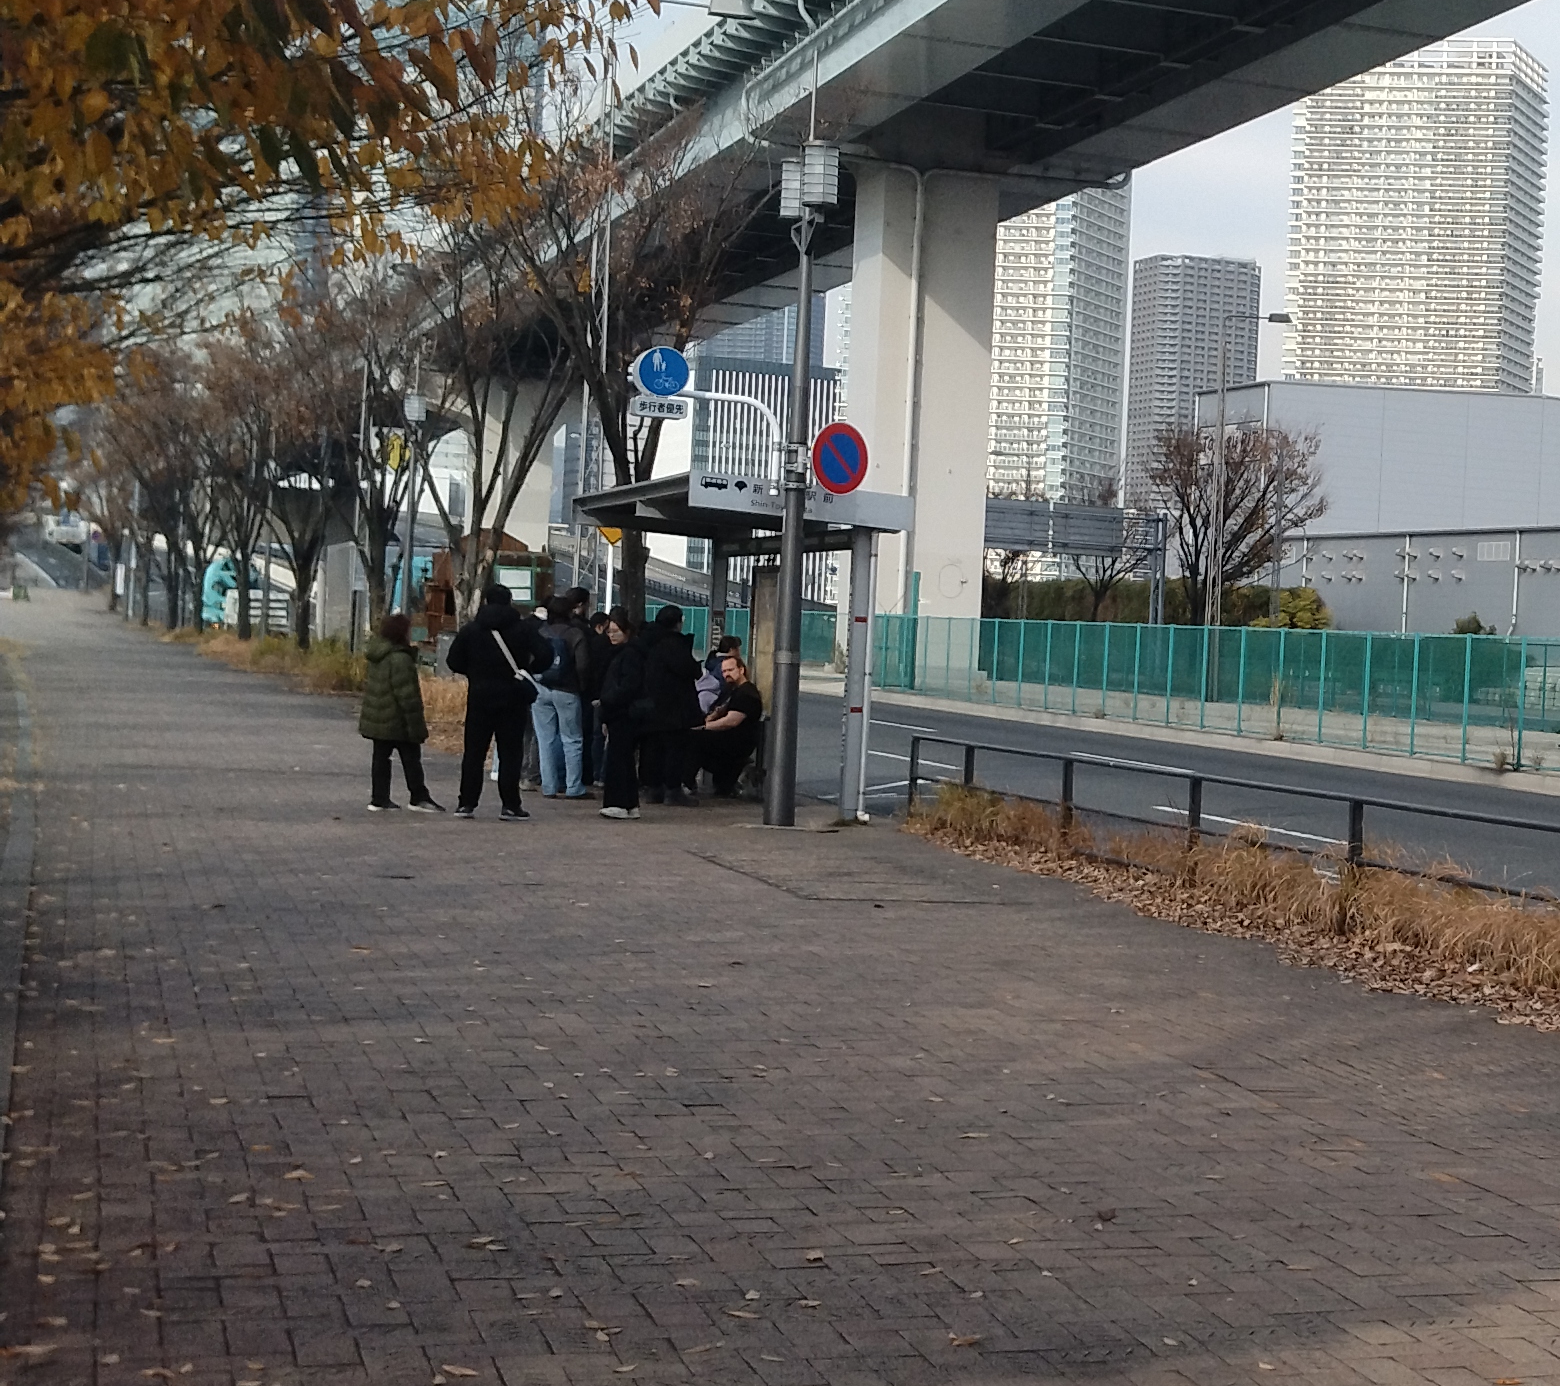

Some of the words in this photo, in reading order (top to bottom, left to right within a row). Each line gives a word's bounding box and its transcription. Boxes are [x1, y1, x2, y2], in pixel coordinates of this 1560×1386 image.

[639, 400, 684, 415] 歩行者優先
